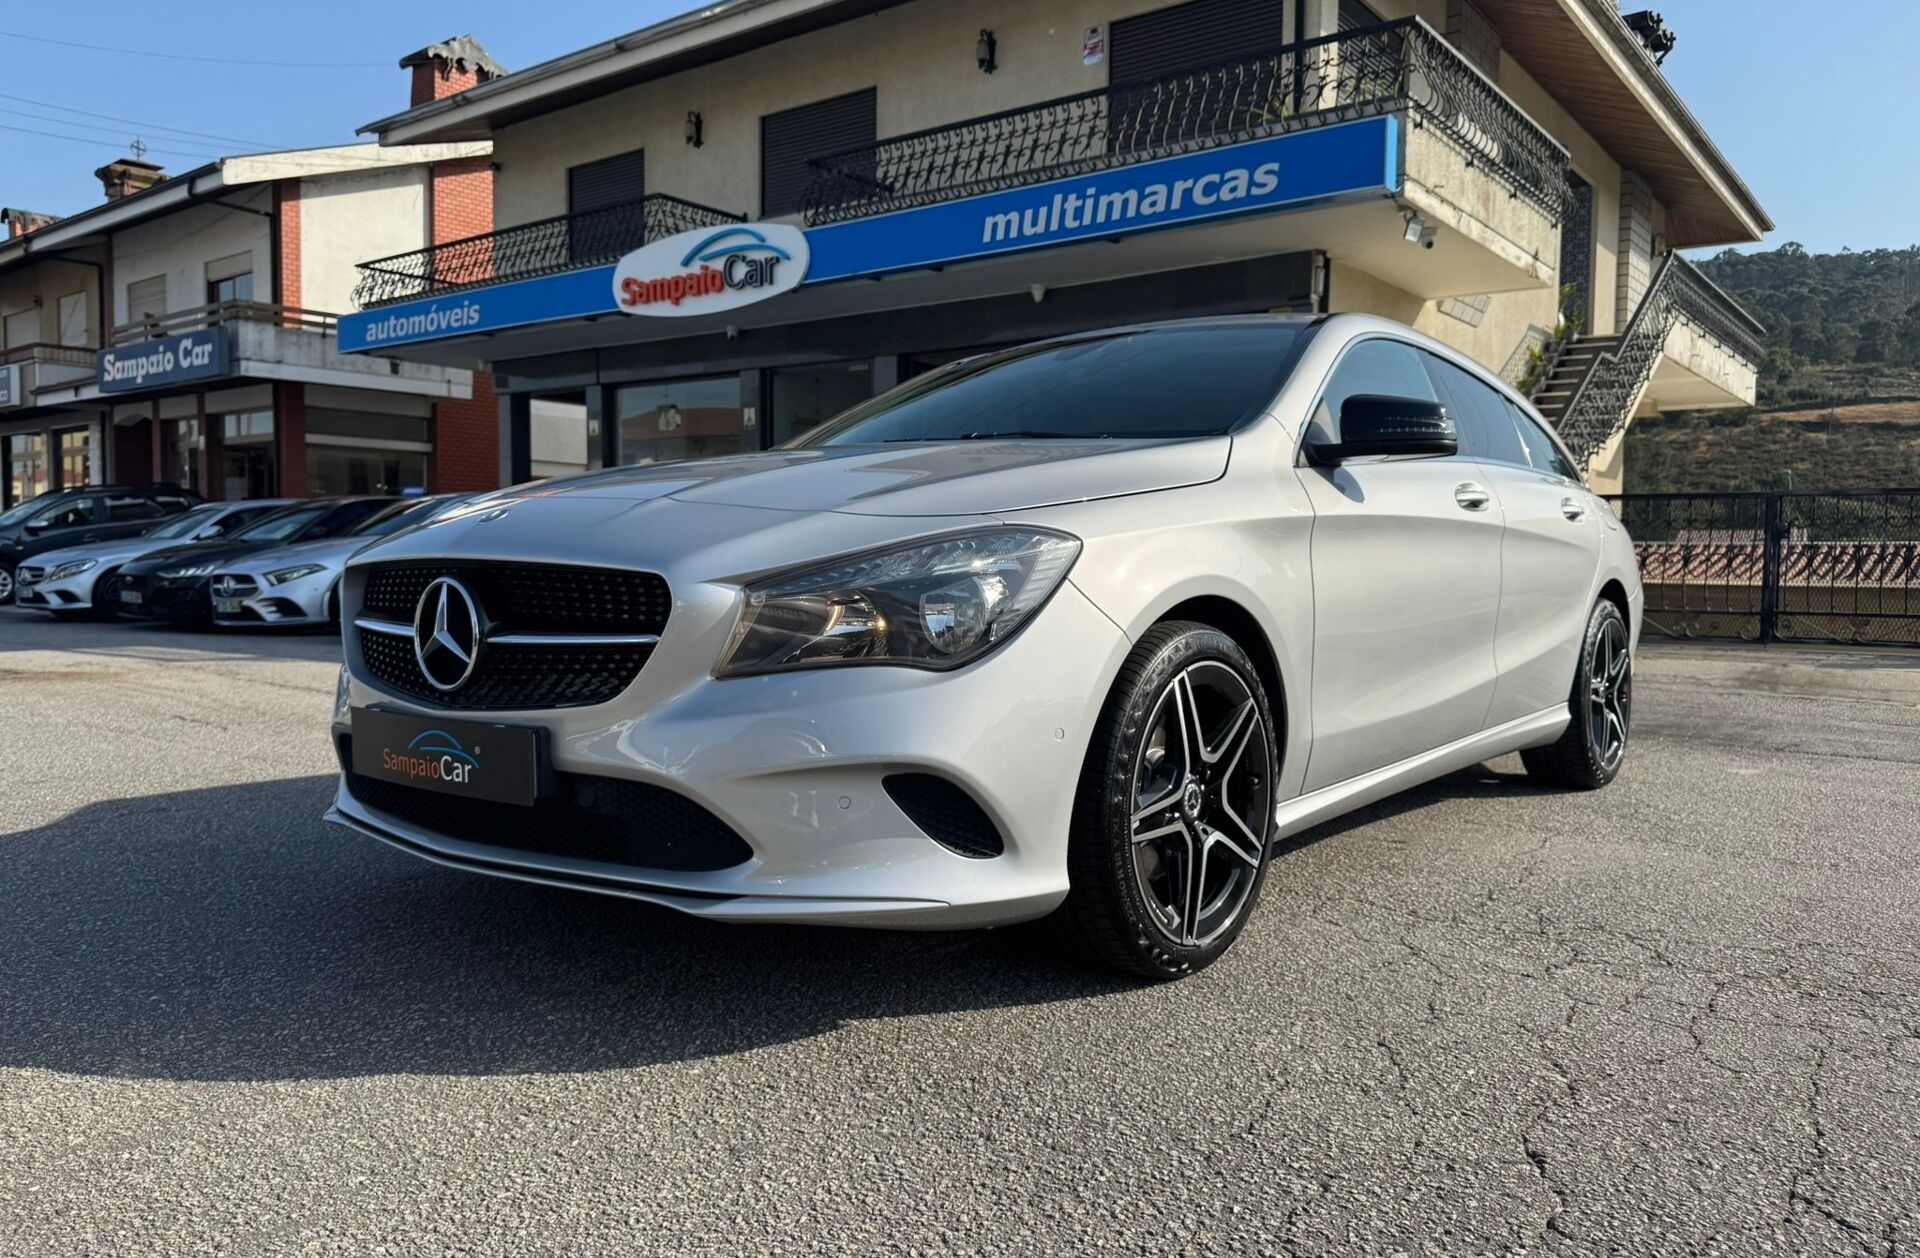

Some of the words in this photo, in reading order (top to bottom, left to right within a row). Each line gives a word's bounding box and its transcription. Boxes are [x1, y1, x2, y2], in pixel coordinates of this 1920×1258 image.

[982, 161, 1281, 243] multimarcas
[366, 300, 480, 342] automóveis
[103, 345, 174, 384] Sampaio
[179, 338, 213, 368] Car
[383, 748, 472, 783] SampaioCar
